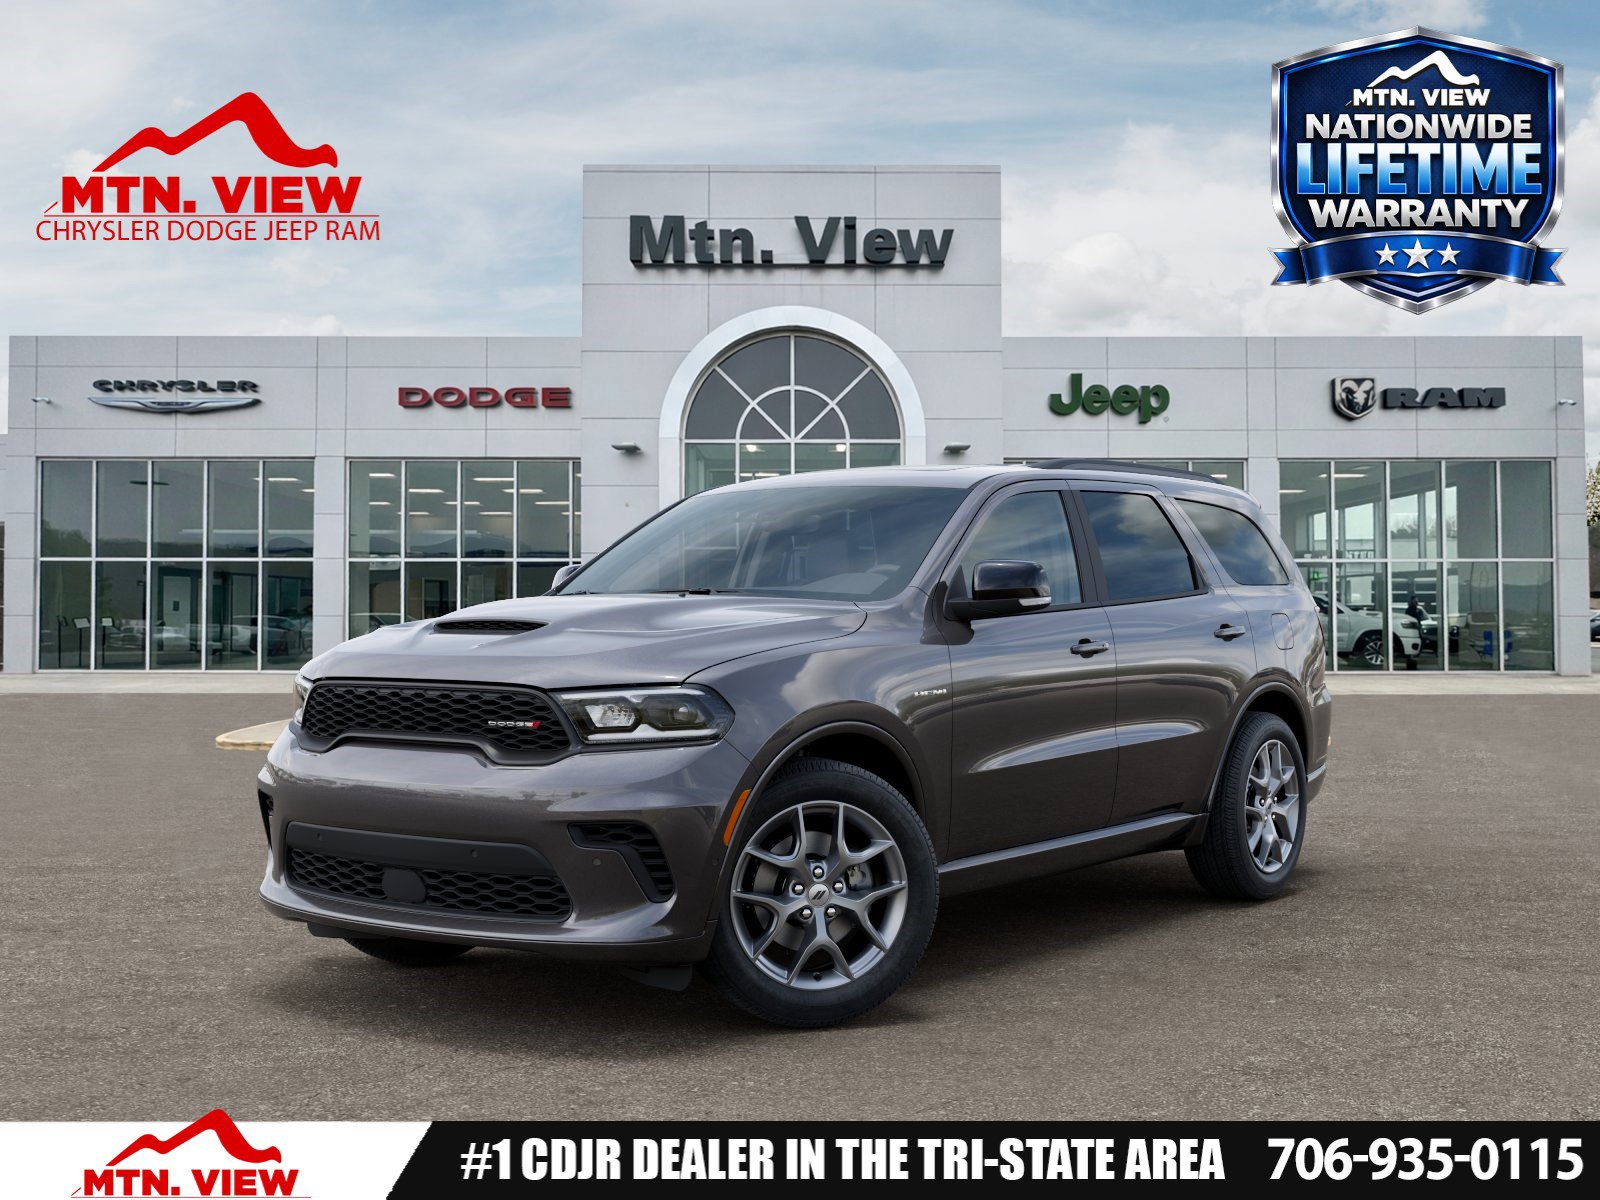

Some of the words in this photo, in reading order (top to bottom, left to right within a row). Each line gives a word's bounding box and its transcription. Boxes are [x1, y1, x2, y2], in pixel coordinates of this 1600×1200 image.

[629, 215, 774, 264] Mtn.
[794, 215, 955, 264] View
[92, 378, 261, 394] CHRYSLER
[397, 386, 573, 409] DODGE
[1048, 373, 1170, 424] Jeep
[1382, 386, 1507, 410] RAM
[487, 720, 534, 728] DODGE
